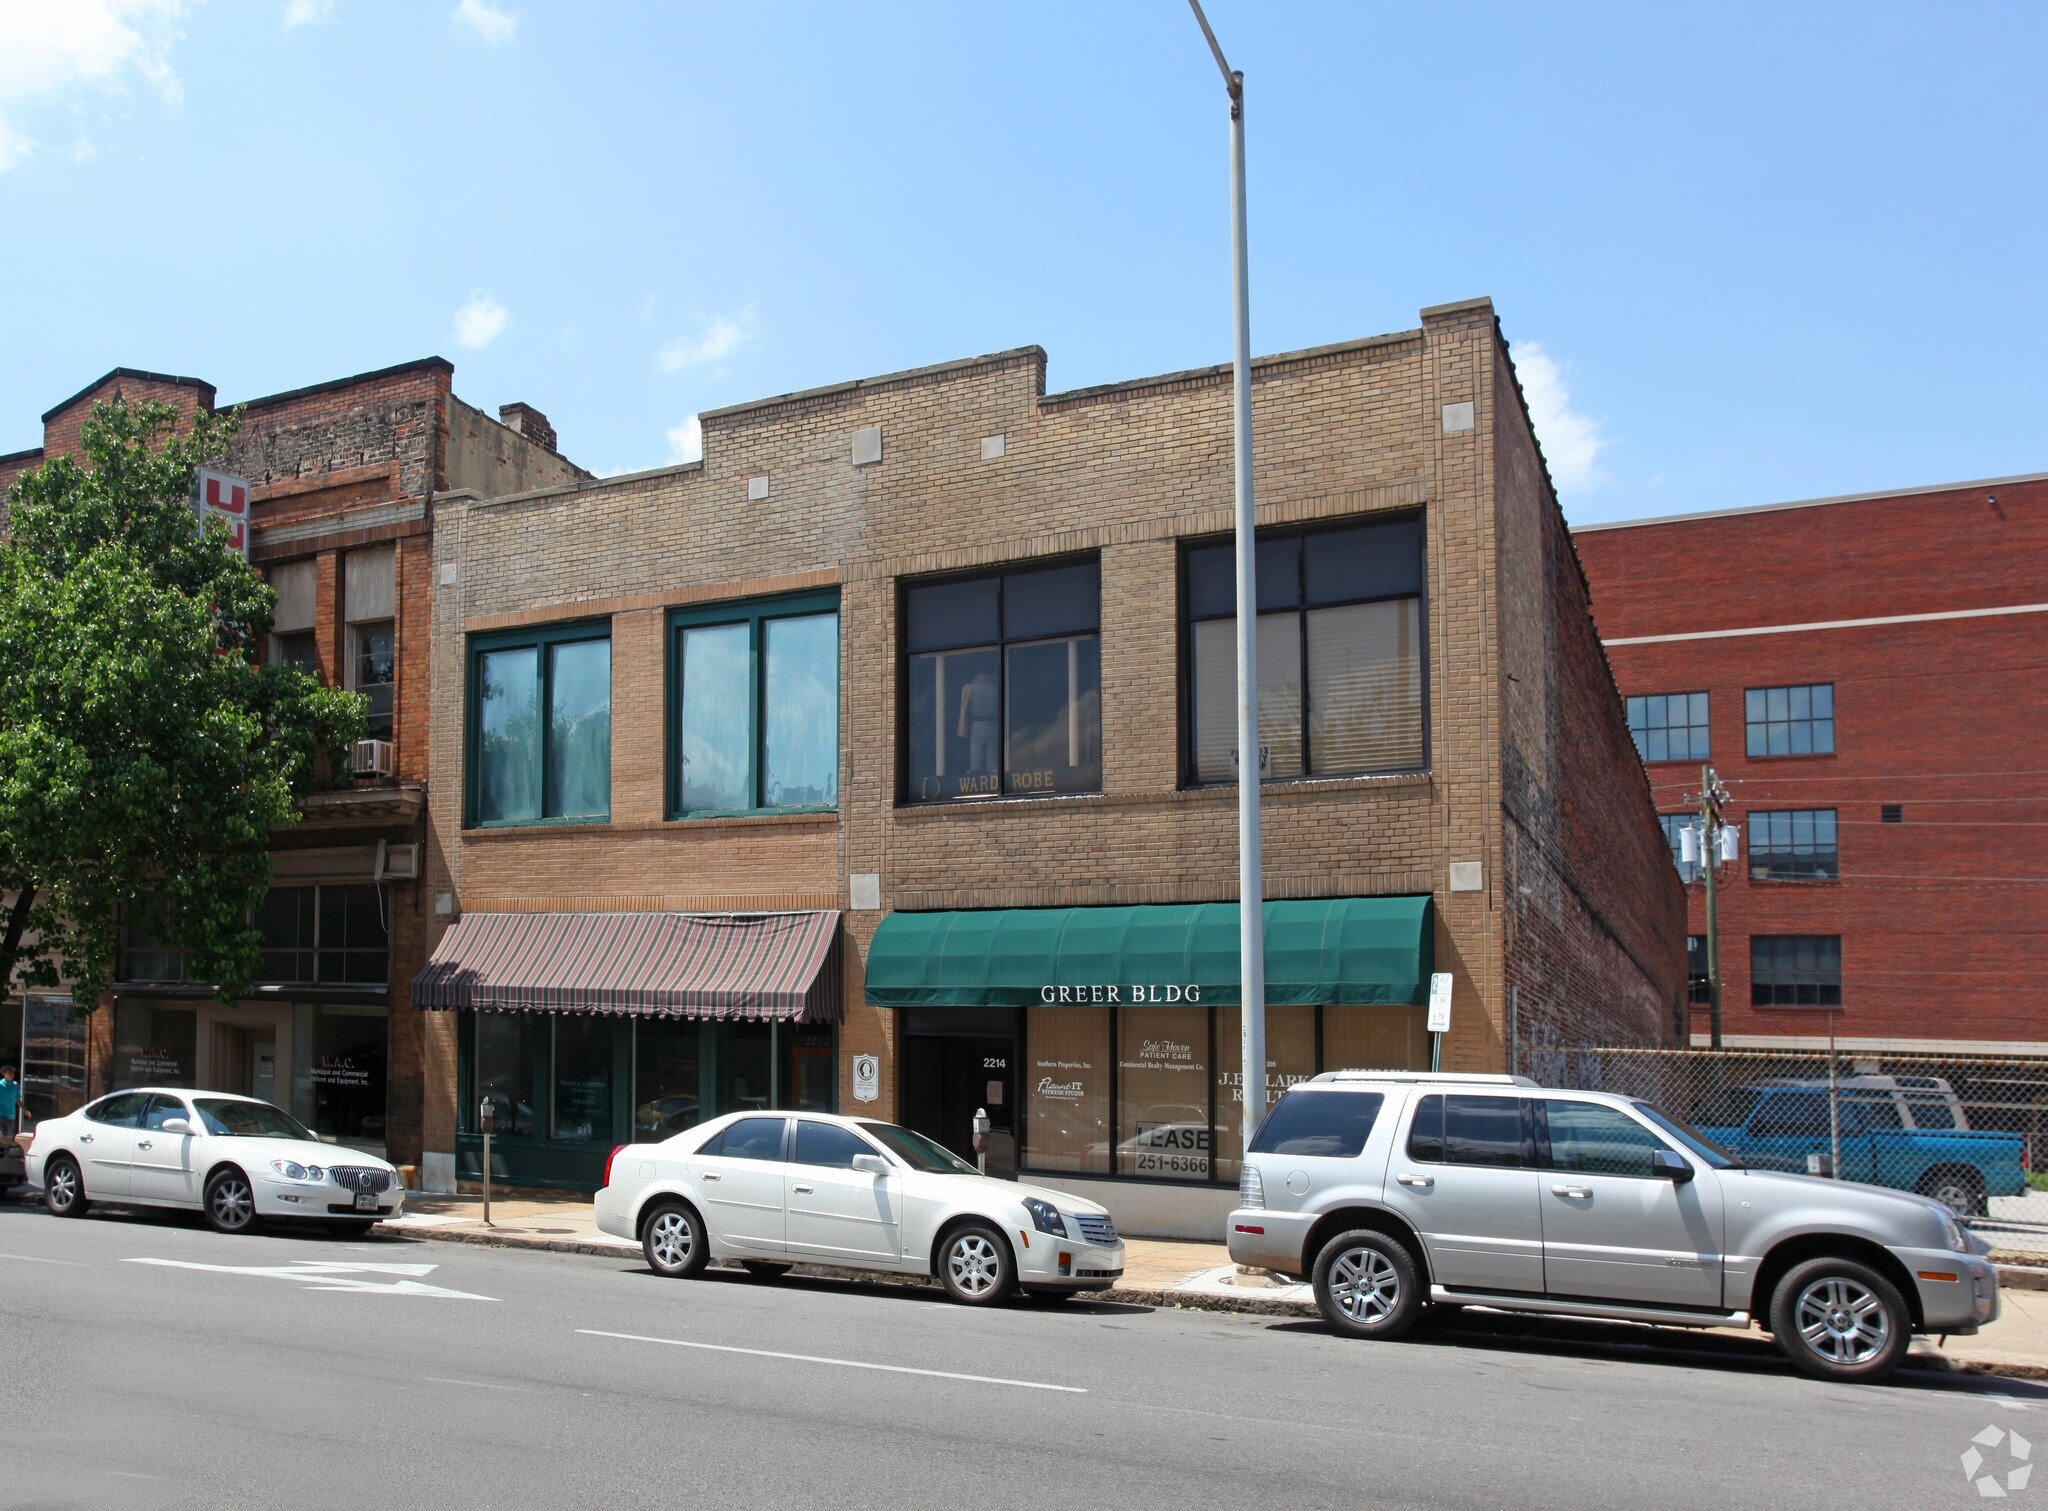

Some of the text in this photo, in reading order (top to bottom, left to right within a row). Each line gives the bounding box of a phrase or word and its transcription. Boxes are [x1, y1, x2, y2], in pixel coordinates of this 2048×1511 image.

[1433, 977, 1438, 990] 2
[1041, 984, 1200, 1003] GREER BLDG
[1142, 1040, 1190, 1052] Safe Haven
[983, 1057, 1006, 1068] 2214
[1119, 1061, 1146, 1069] Continental
[1147, 1062, 1162, 1071] Realty
[1164, 1062, 1195, 1071] Management
[311, 1068, 331, 1076] Municipal
[342, 1069, 368, 1077] Commercial
[1072, 1082, 1083, 1090] IT
[1137, 1127, 1209, 1150] LEASE
[1138, 1154, 1208, 1172] 251-6366
